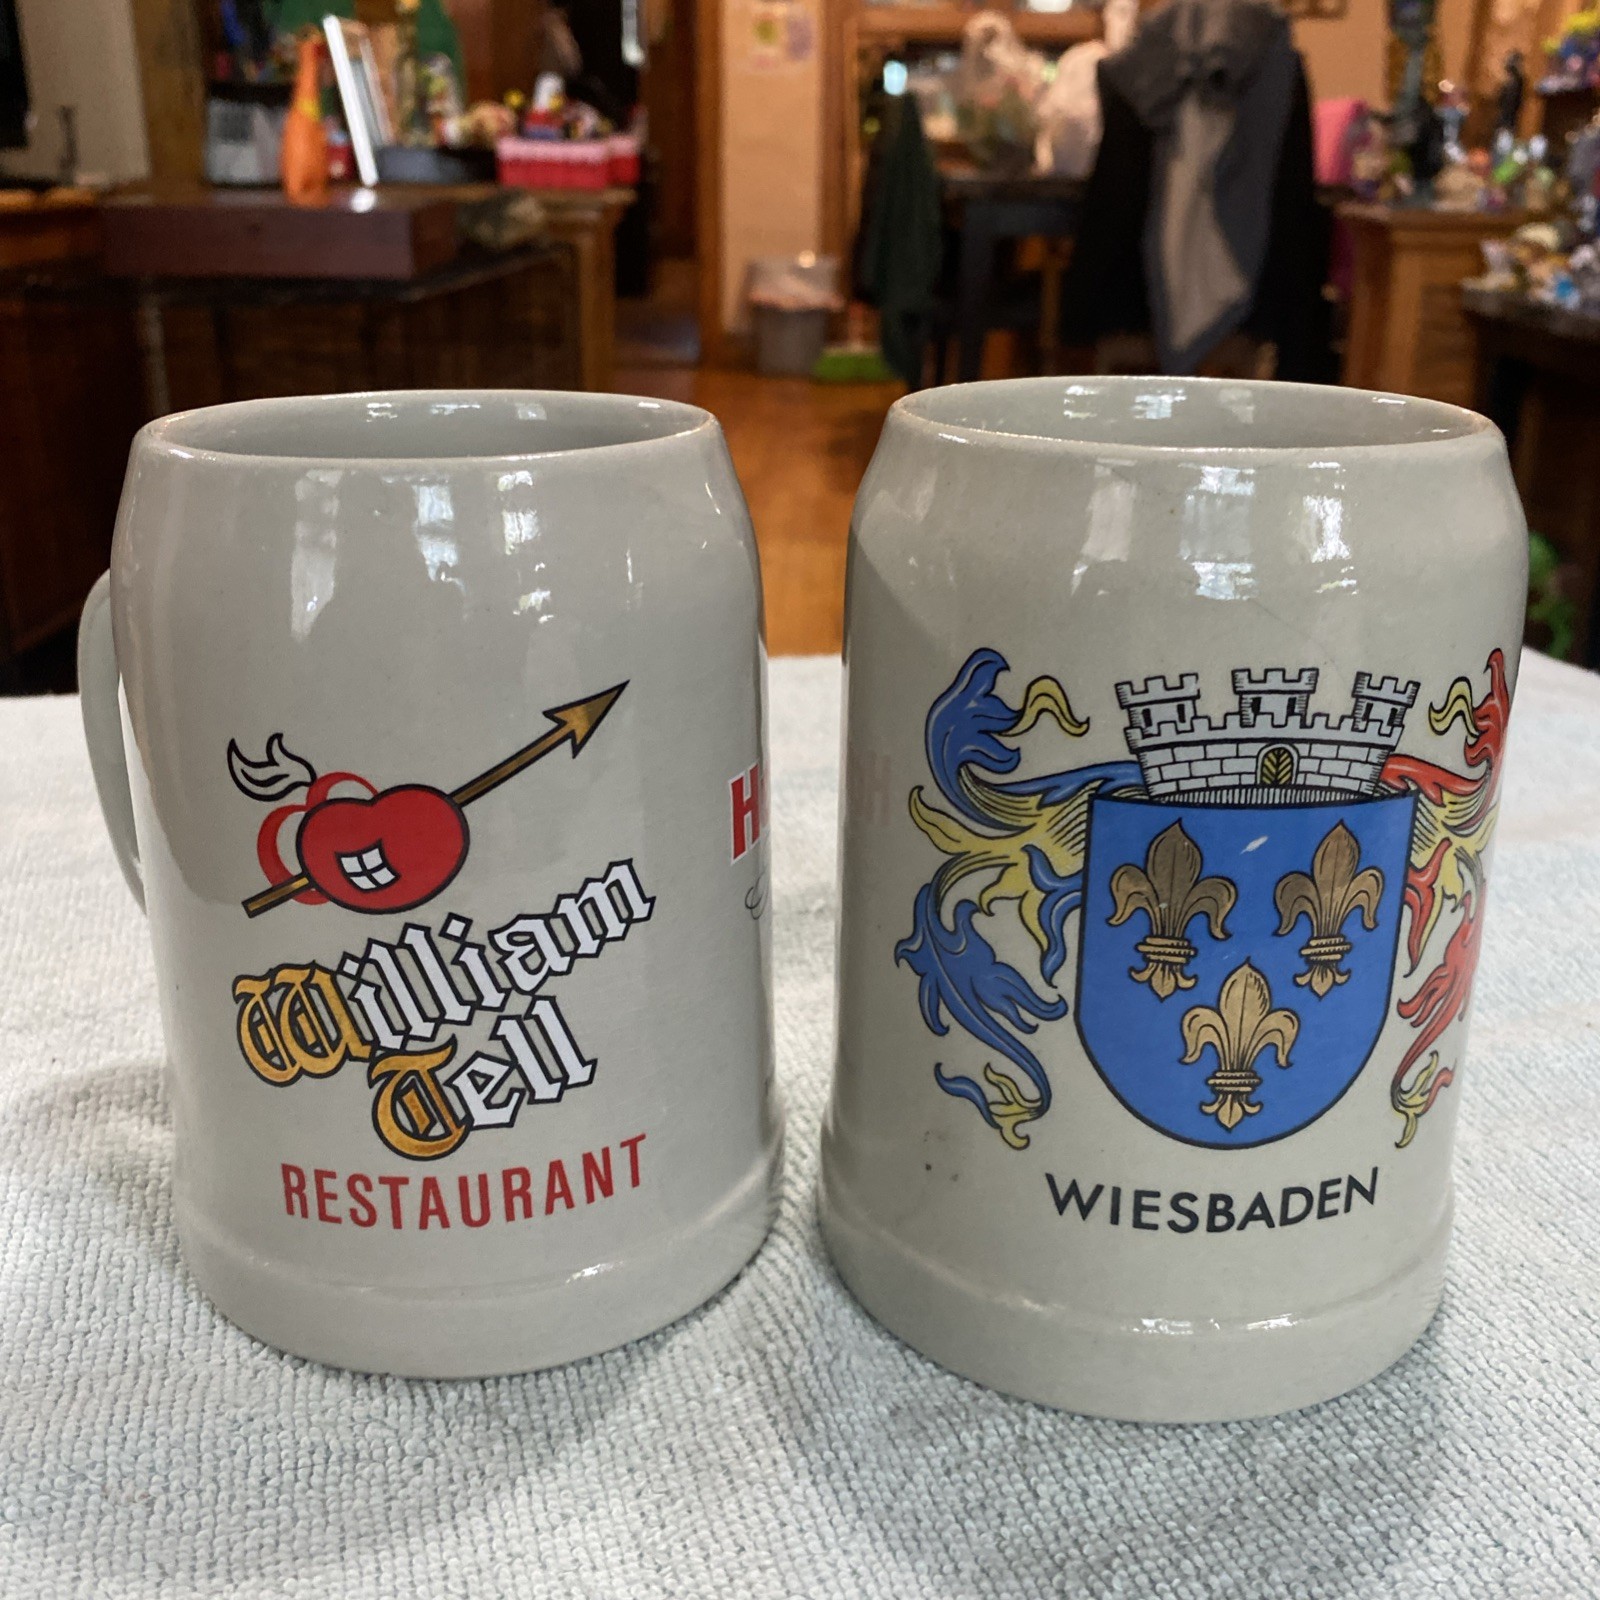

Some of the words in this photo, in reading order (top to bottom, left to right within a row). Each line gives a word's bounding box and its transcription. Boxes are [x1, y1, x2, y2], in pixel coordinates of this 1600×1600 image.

[232, 858, 656, 1087] William
[367, 995, 598, 1161] Tell
[280, 1133, 647, 1230] RESTAURANT
[1045, 1166, 1378, 1234] WIESBADEN
